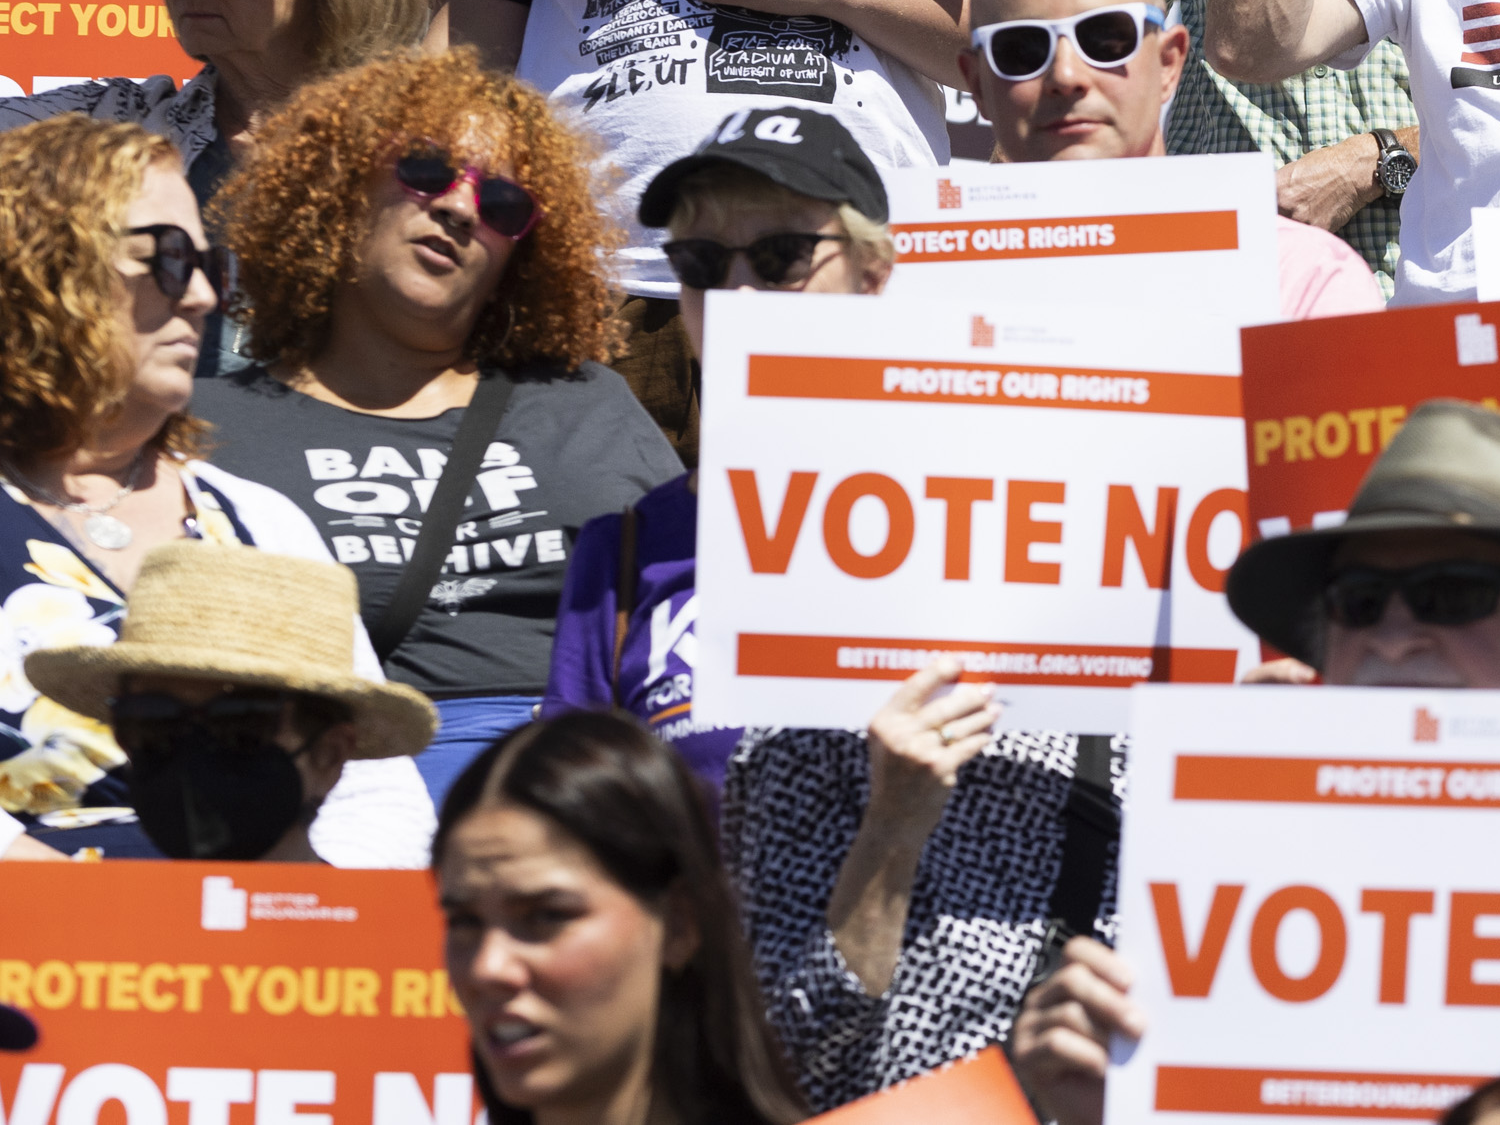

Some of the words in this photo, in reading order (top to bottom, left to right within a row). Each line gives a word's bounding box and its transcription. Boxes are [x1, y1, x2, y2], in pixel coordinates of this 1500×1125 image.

[714, 51, 796, 67] STADIUM
[804, 52, 822, 66] AT
[894, 230, 969, 254] OTECT
[972, 228, 1025, 251] OUR
[1028, 224, 1115, 249] RIGHTS
[883, 367, 1000, 397] PROTECT
[1002, 371, 1058, 399] OUR
[1060, 374, 1150, 405] RIGHTS
[1254, 407, 1405, 466] PROTE
[725, 468, 1067, 586] VOTE
[1099, 483, 1249, 594] NO
[1316, 765, 1447, 798] PROTECT
[0, 960, 211, 1012] ROTECT
[219, 965, 381, 1016] YOUR
